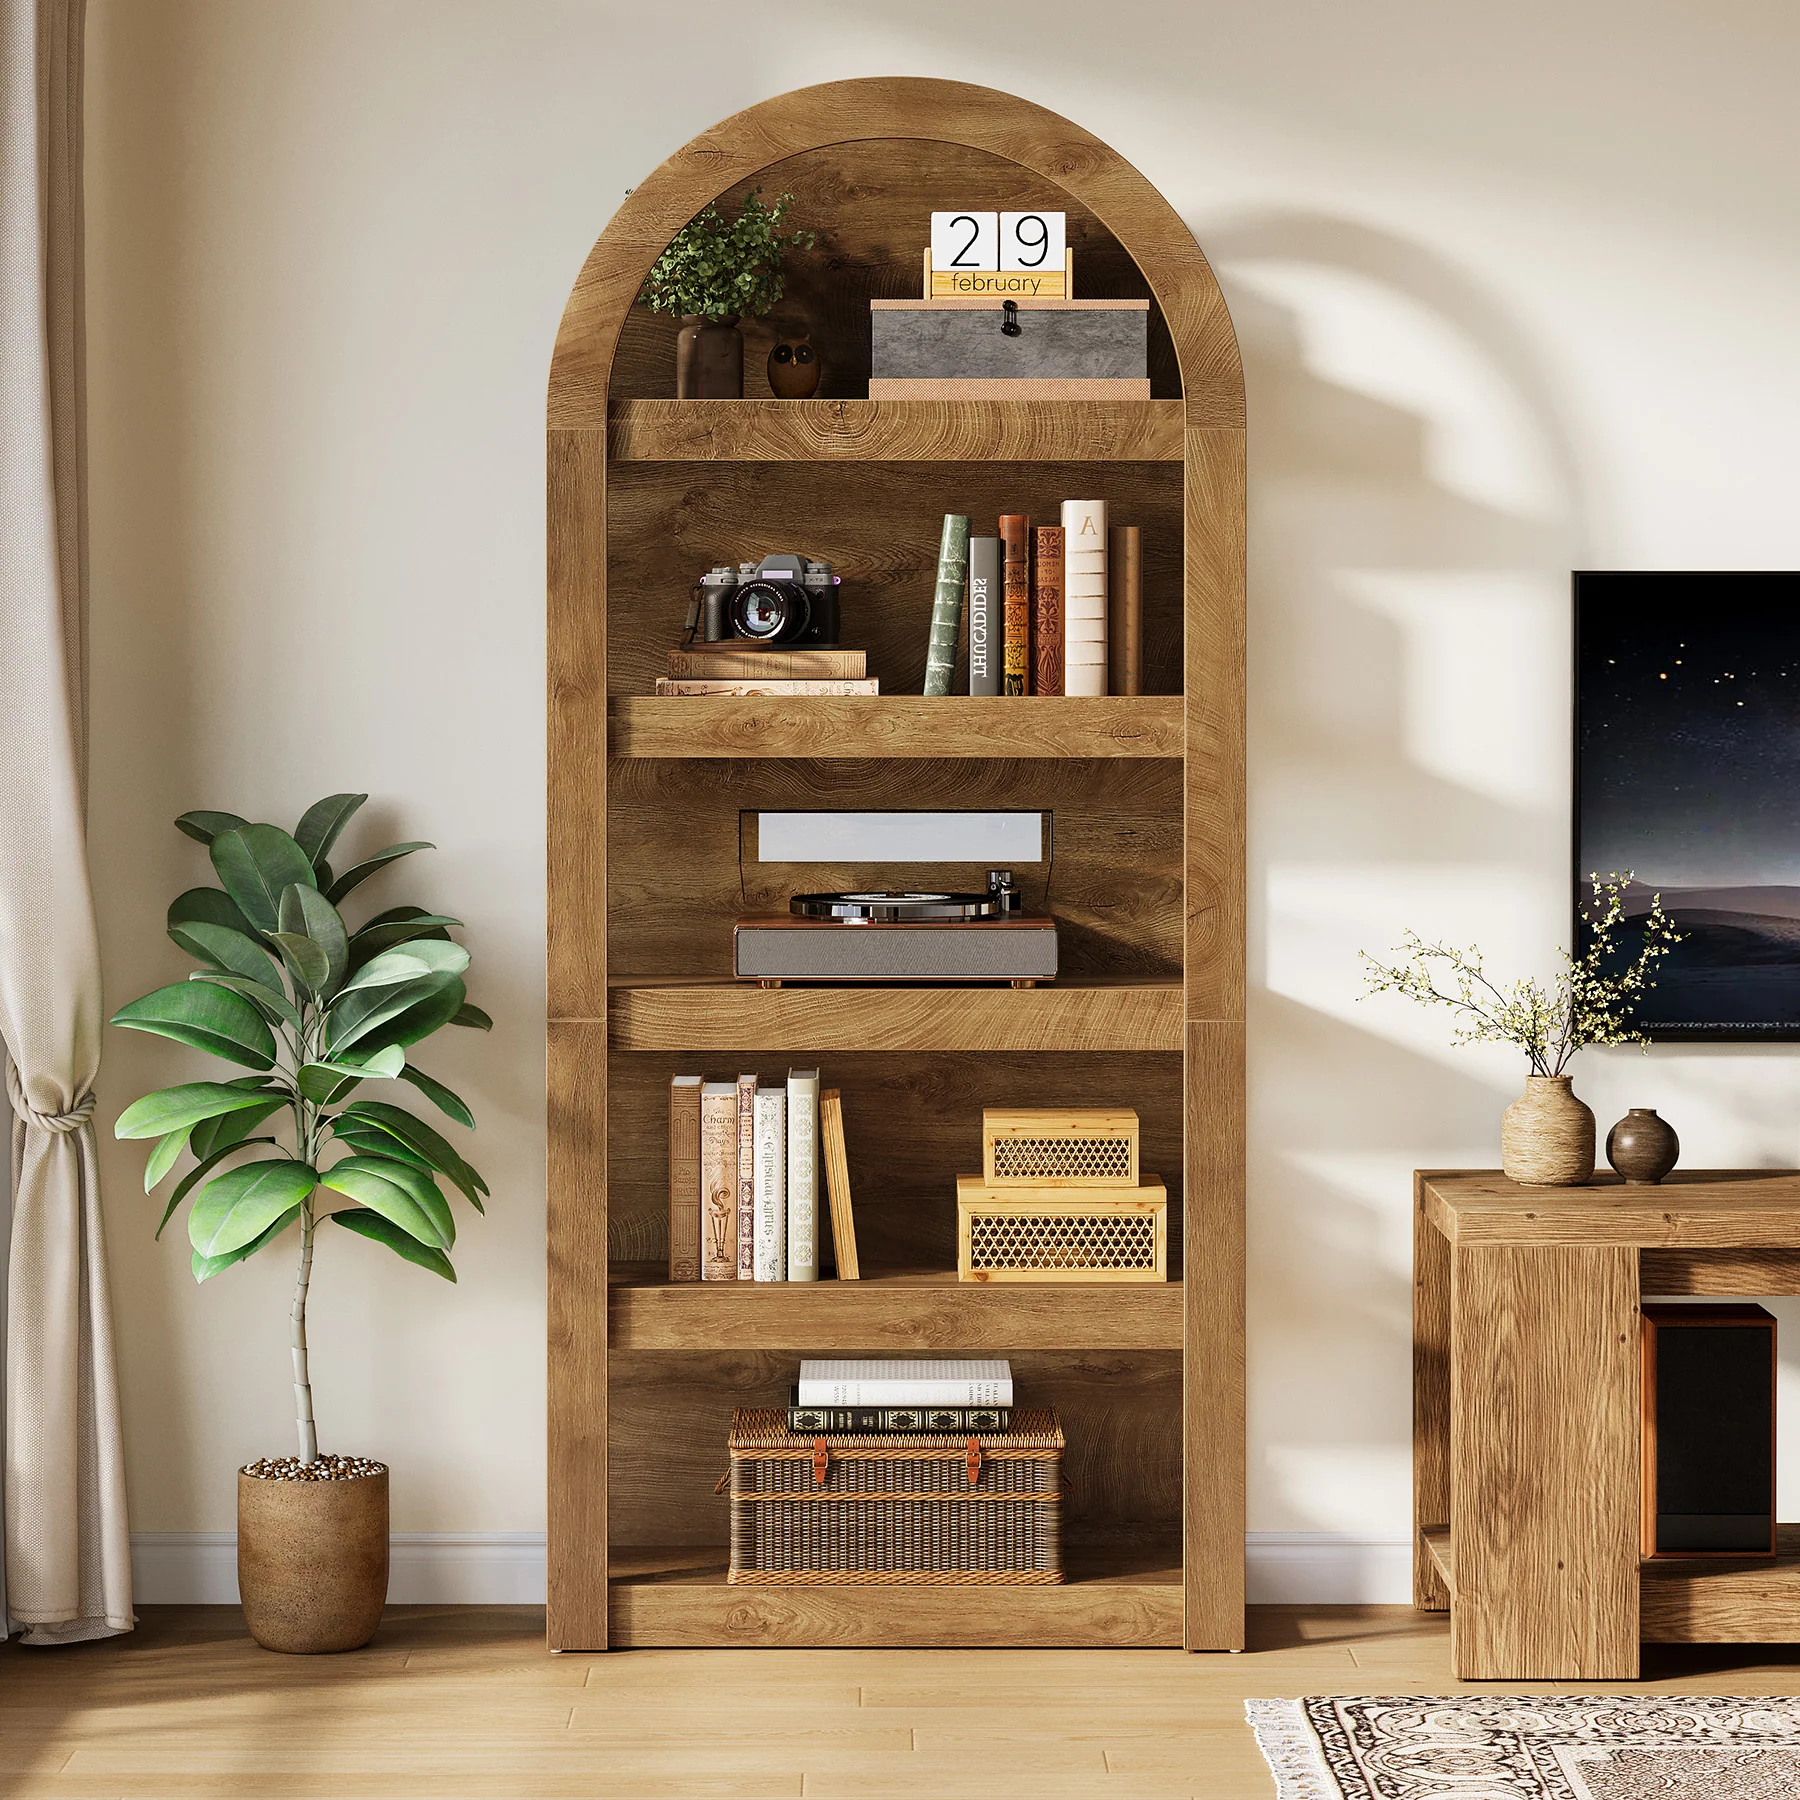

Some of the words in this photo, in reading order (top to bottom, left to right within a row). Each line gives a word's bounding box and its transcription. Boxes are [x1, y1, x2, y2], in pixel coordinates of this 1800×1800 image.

[949, 215, 981, 267] 2
[1015, 215, 1049, 267] 9
[951, 272, 1042, 296] february
[1079, 515, 1099, 536] A
[703, 1114, 736, 1125] Charm
